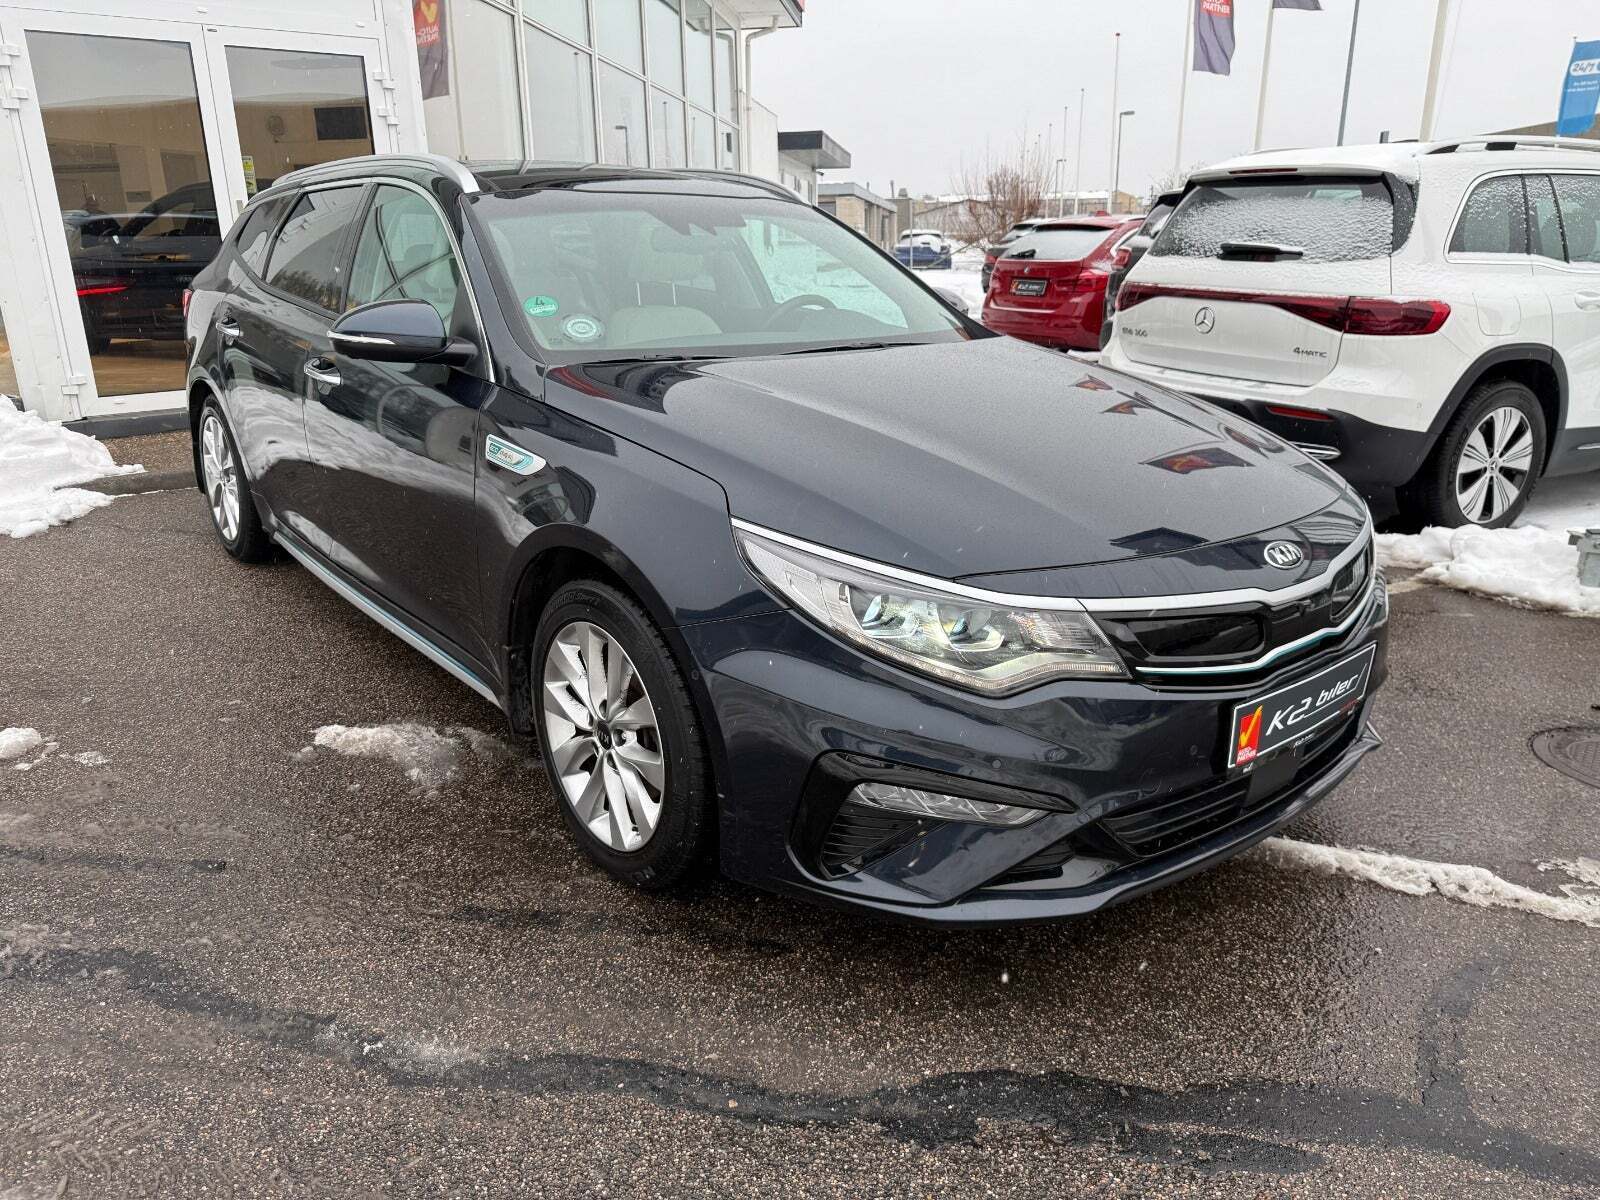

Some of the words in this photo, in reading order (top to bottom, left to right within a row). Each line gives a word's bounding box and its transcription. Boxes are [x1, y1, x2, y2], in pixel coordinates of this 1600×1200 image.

[1293, 347, 1327, 358] 4MATIC
[1268, 544, 1301, 565] KIA
[1315, 674, 1358, 707] biler
